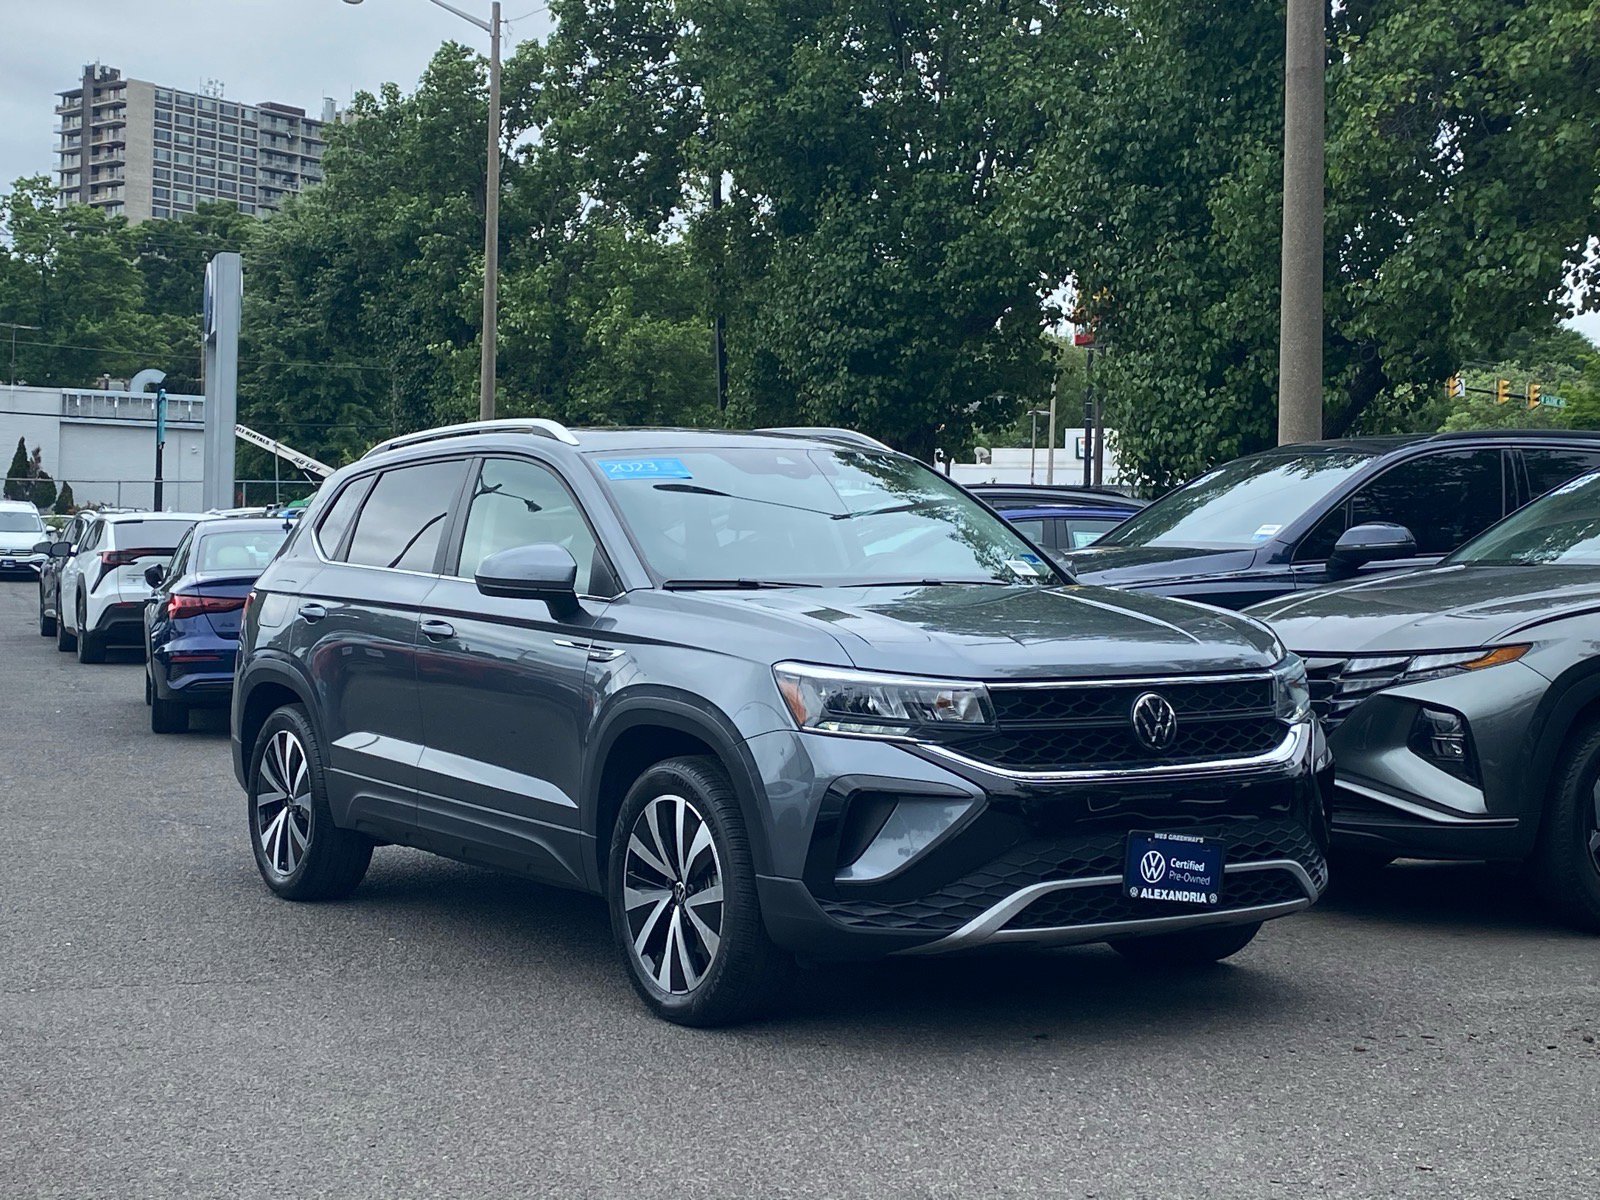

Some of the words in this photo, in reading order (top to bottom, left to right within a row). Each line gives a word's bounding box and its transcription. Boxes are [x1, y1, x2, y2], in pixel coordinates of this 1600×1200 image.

[605, 461, 659, 474] 2023
[1170, 858, 1205, 871] Certified
[1169, 870, 1210, 885] Pre-Owned
[1140, 888, 1207, 903] ALEXANDRIA
